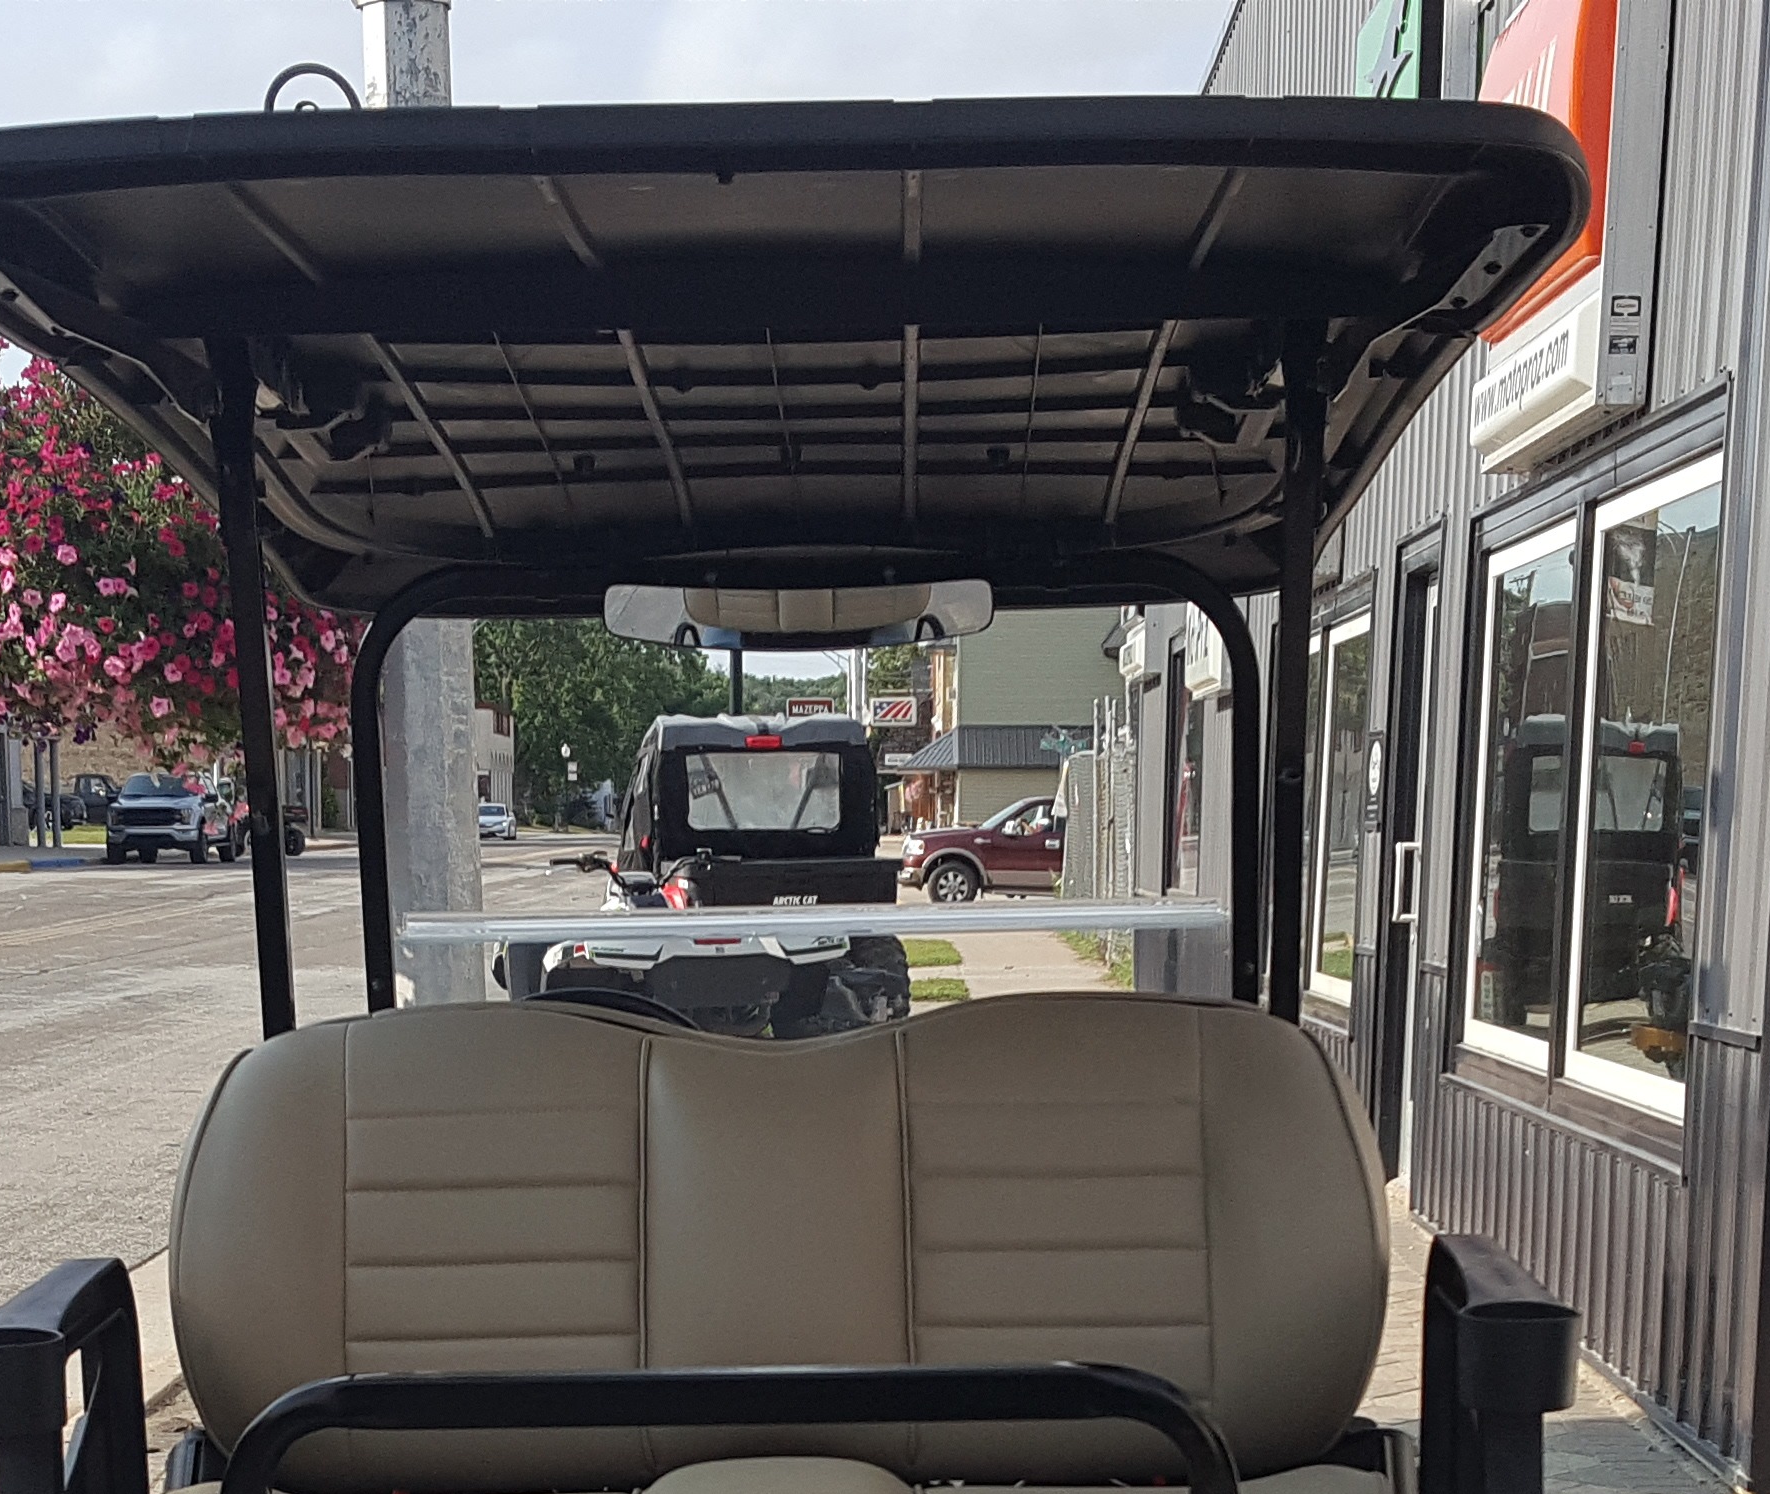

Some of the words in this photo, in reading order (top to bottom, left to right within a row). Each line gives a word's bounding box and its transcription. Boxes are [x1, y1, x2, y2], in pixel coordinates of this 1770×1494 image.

[1474, 329, 1569, 428] www.motoproz.com
[791, 704, 829, 715] MAZEPPA
[772, 895, 801, 906] ARCTIC
[802, 894, 818, 905] CAT
